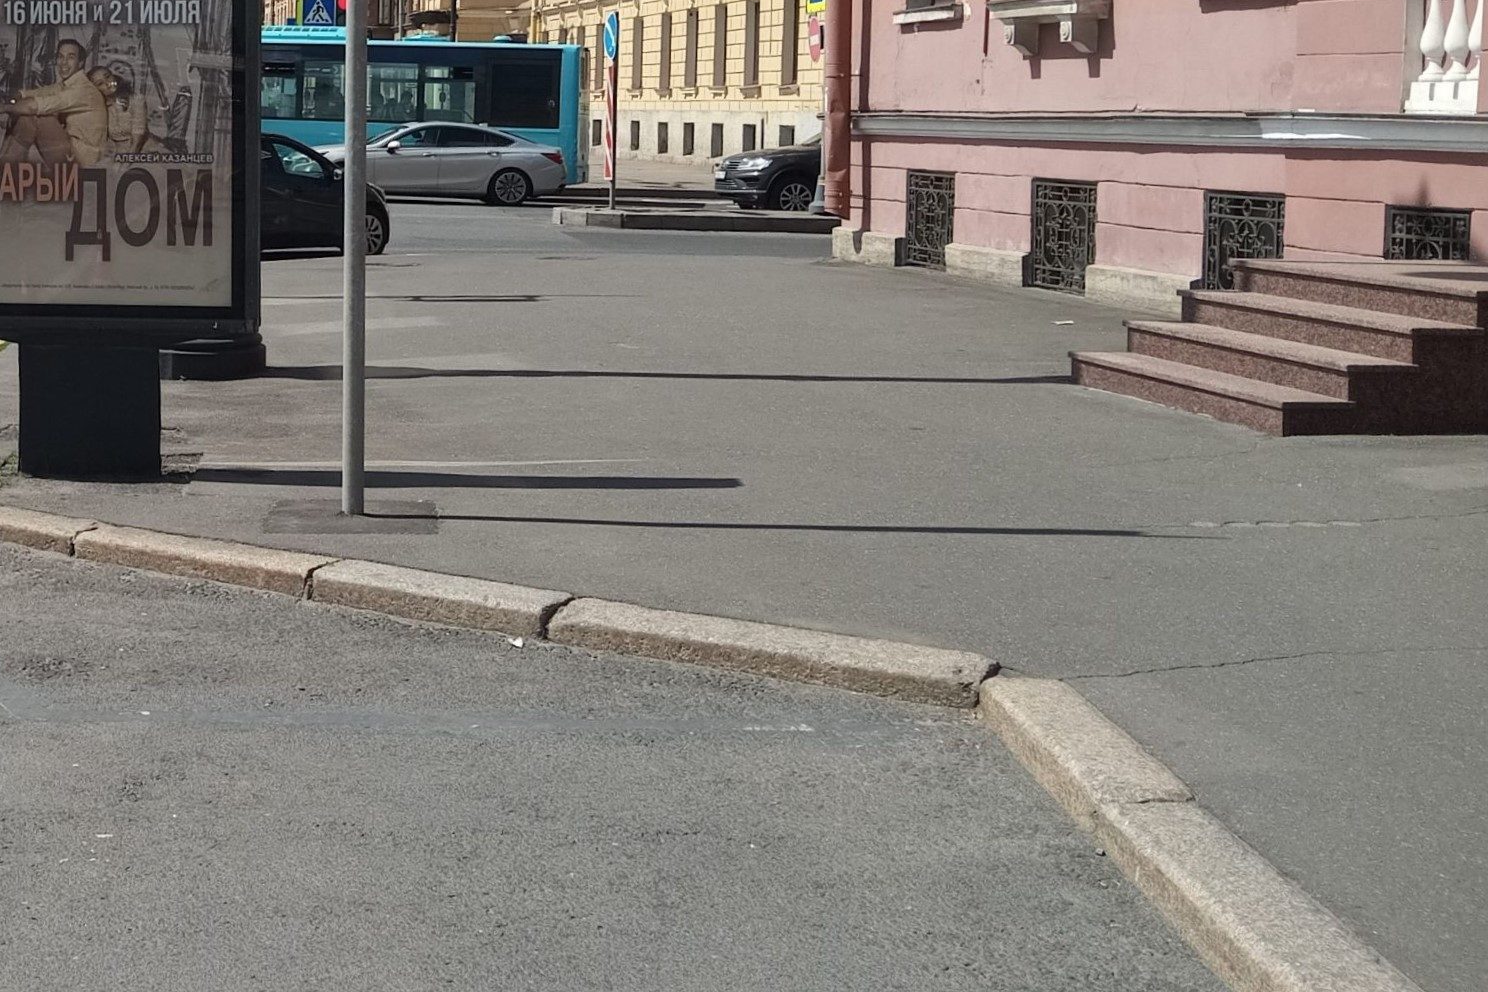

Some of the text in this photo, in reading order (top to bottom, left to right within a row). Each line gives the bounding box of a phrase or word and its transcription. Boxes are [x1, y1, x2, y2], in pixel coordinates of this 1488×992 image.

[3, 0, 26, 25] 16
[30, 0, 87, 25] ИЮНЯ
[109, 0, 134, 25] 21
[139, 0, 201, 25] ИЮЛЯ
[115, 151, 214, 163] АЛЕКСЕЙ КАЗАНЦЕВ
[64, 167, 213, 262] ДОМ
